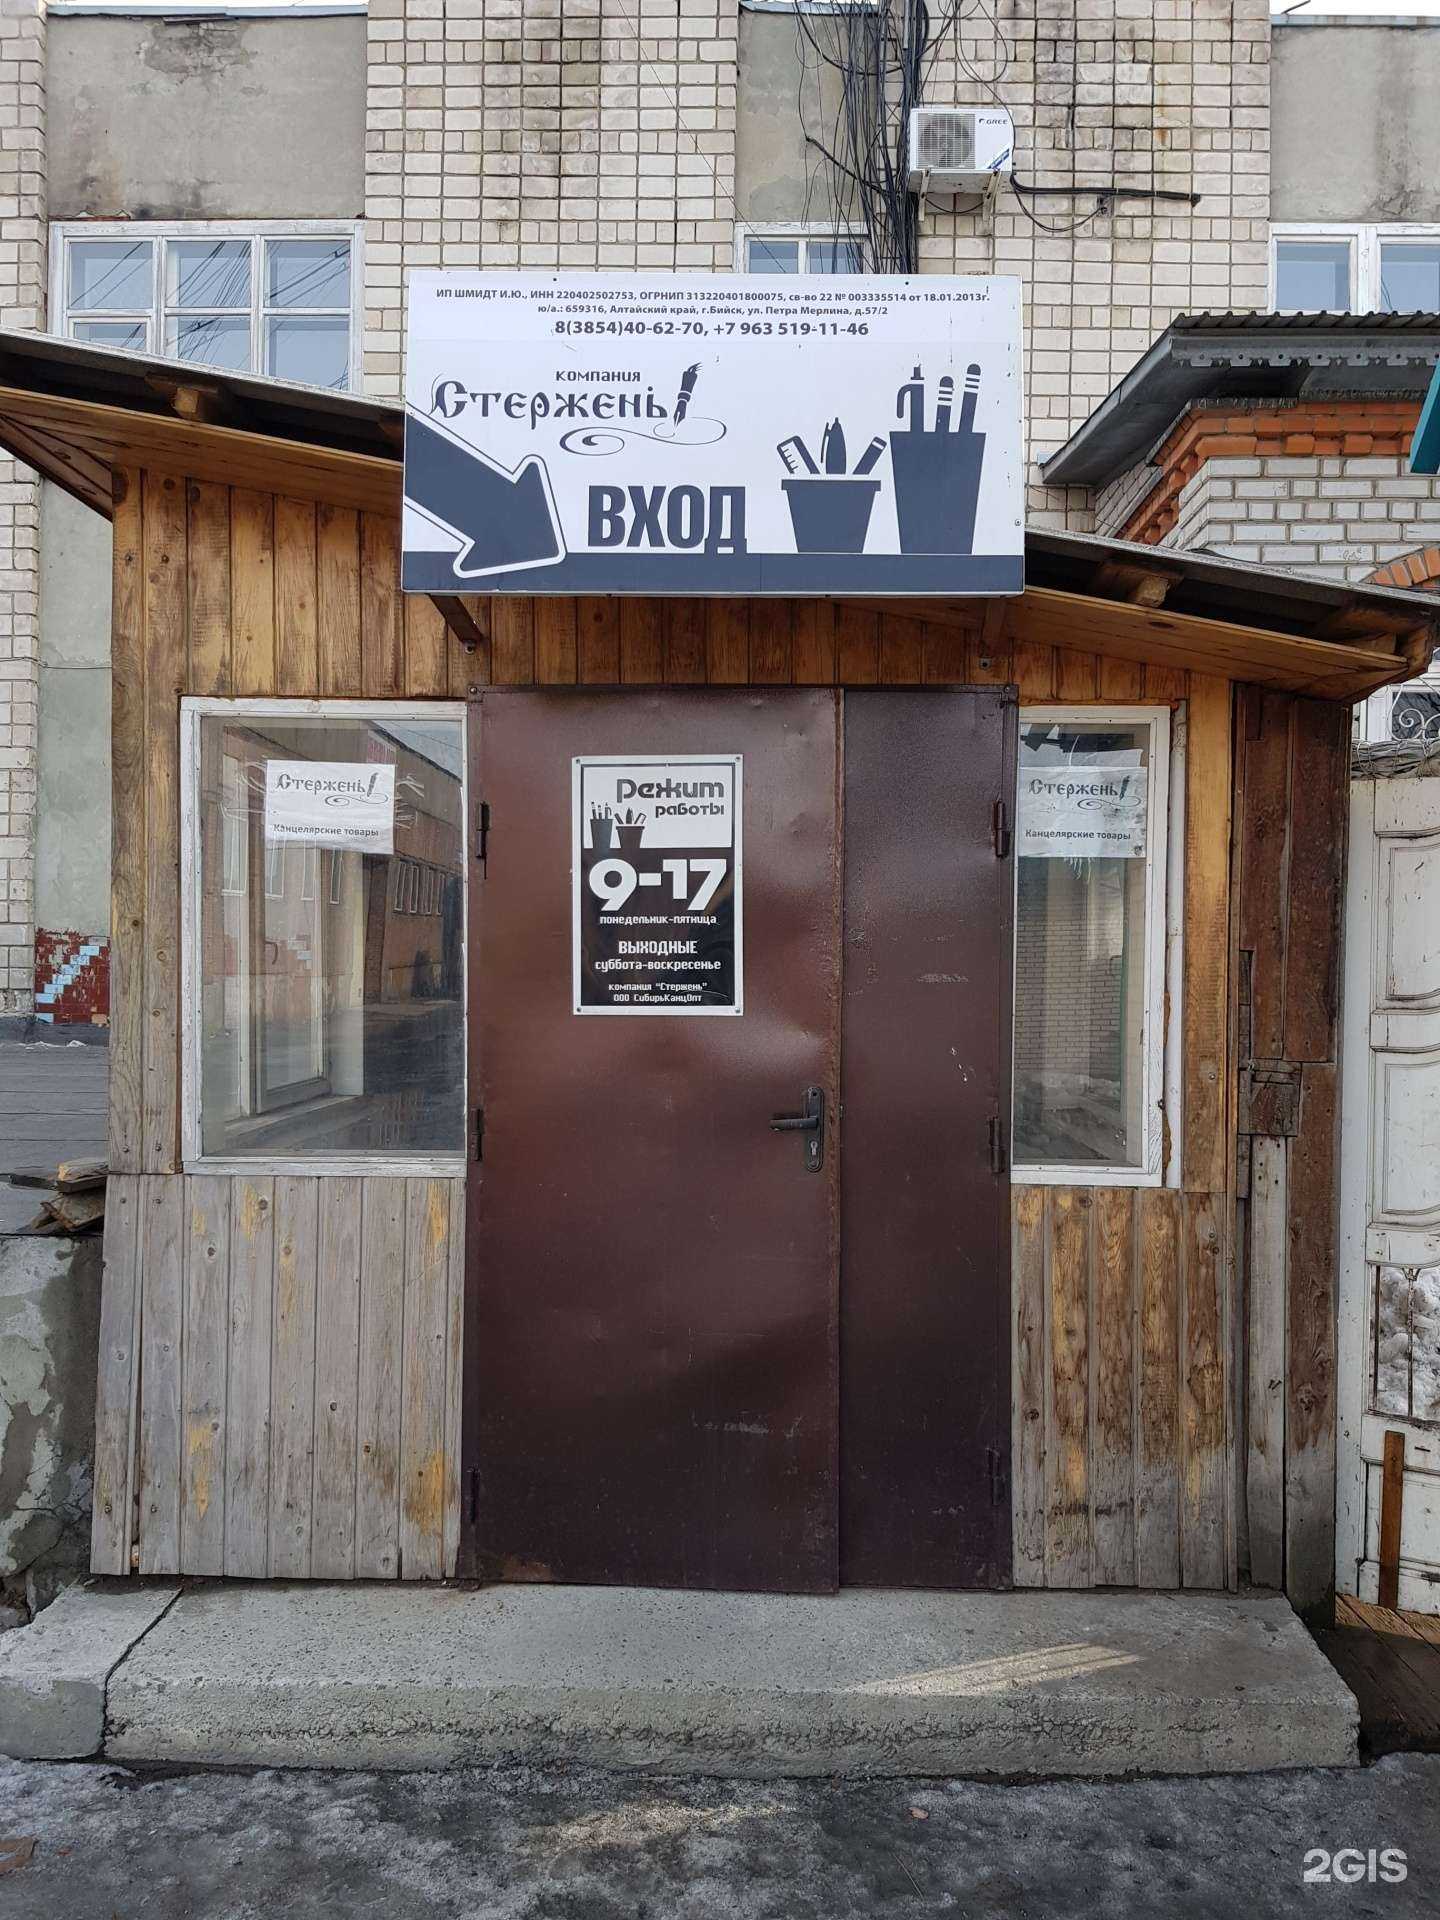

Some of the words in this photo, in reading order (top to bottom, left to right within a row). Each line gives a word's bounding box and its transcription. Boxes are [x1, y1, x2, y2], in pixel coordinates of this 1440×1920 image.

[436, 289, 452, 298] ИП
[454, 289, 497, 300] ШМИДТ
[499, 289, 528, 300] И.Ю.,
[530, 290, 554, 299] ИНН
[556, 290, 637, 301] 220402502753,
[639, 291, 684, 301] ОГРНИП
[686, 291, 786, 302] 313220401800075,
[788, 293, 818, 301] св-во
[819, 292, 833, 301] 22
[835, 292, 846, 301] №
[848, 292, 907, 302] 003335514
[908, 294, 922, 302] от
[923, 293, 990, 302] 18.01.2013г.
[537, 304, 564, 313] ю/а.:
[565, 304, 607, 315] 659316,
[610, 304, 668, 314] Алтайский
[670, 305, 699, 315] край,
[701, 305, 745, 315] г.Бийск,
[747, 307, 763, 316] ул.
[765, 306, 798, 316] Петра
[800, 306, 852, 317] Мерлина,
[854, 306, 888, 316] д.57/2
[554, 320, 709, 337] 8(3854)40-62-70,
[713, 321, 736, 335] +7
[739, 322, 773, 335] 963
[777, 322, 869, 336] 519-11-46
[555, 369, 641, 383] компания
[587, 484, 748, 555] ВХОД
[655, 803, 725, 819] работы
[273, 824, 342, 836] Канцелярские
[344, 828, 379, 837] товары
[1025, 829, 1095, 840] Канцелярские
[1097, 832, 1131, 841] товары
[588, 858, 727, 912] 9-17
[599, 915, 718, 926] понедельник-пятница
[618, 940, 698, 956] ВЫХОДНЫЕ
[594, 958, 722, 973] суббота-воскресенье
[608, 983, 652, 992] компания
[655, 982, 708, 993] "Стержень"
[613, 993, 630, 1002] ООО
